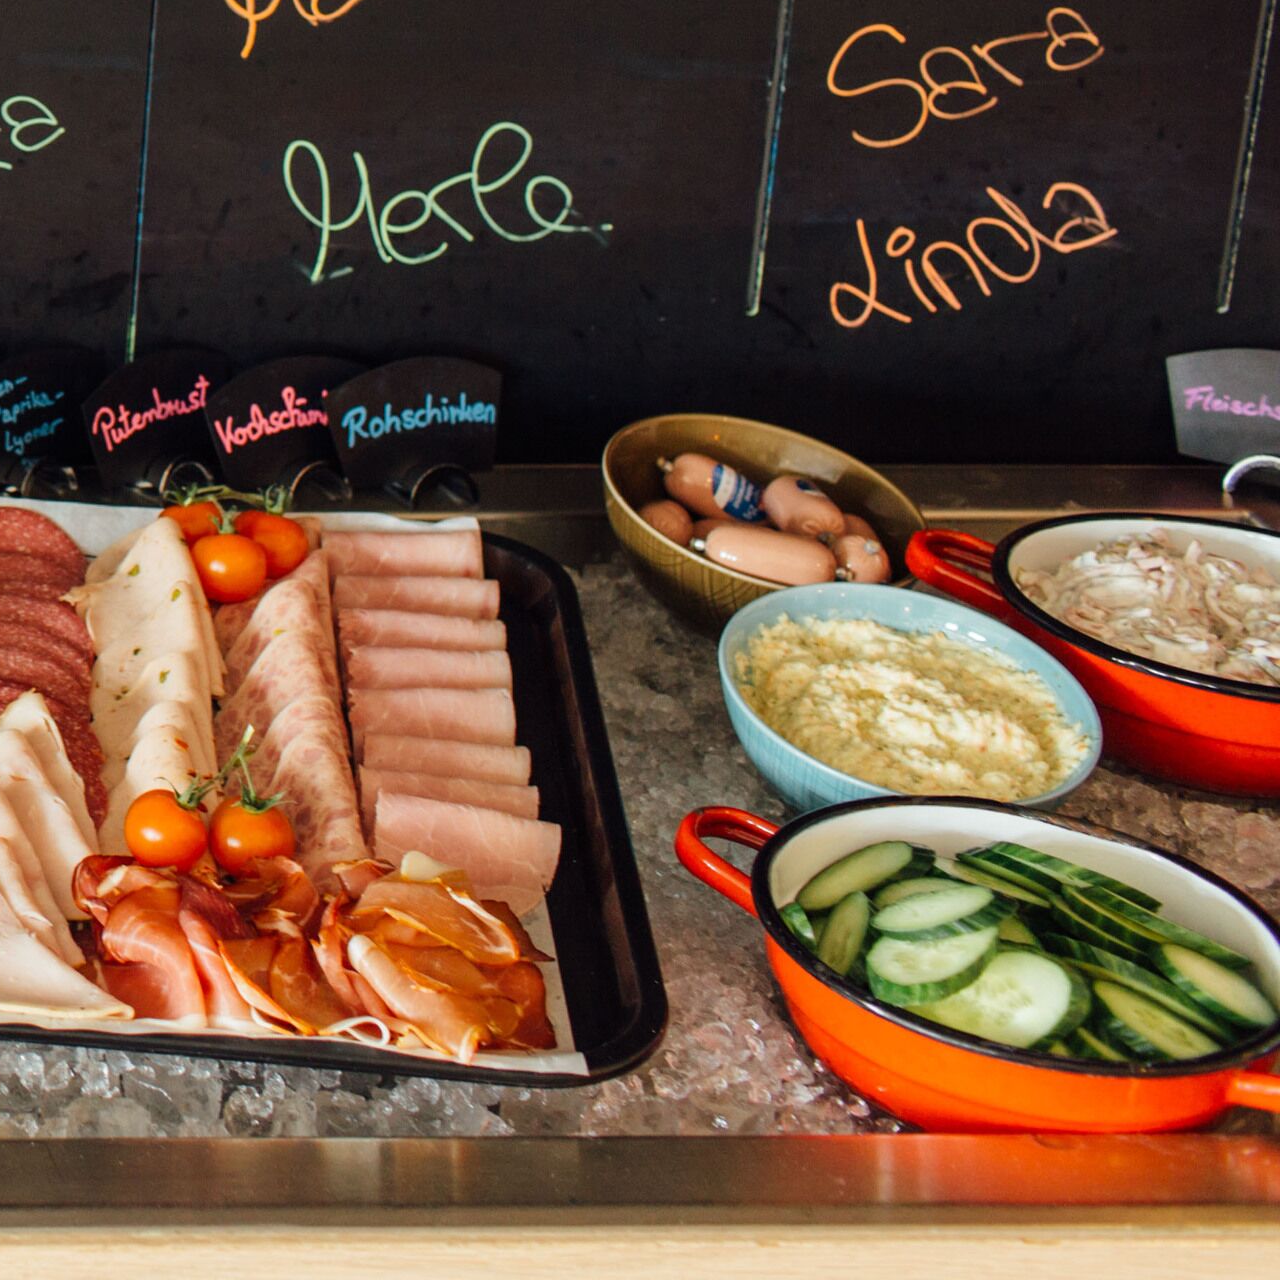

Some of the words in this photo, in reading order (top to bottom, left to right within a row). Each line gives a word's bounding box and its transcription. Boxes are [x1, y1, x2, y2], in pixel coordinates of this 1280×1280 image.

[826, 6, 1105, 148] Sara
[828, 182, 1118, 328] Linda
[92, 374, 210, 452] Putenbrust
[341, 392, 497, 449] Rohschinken
